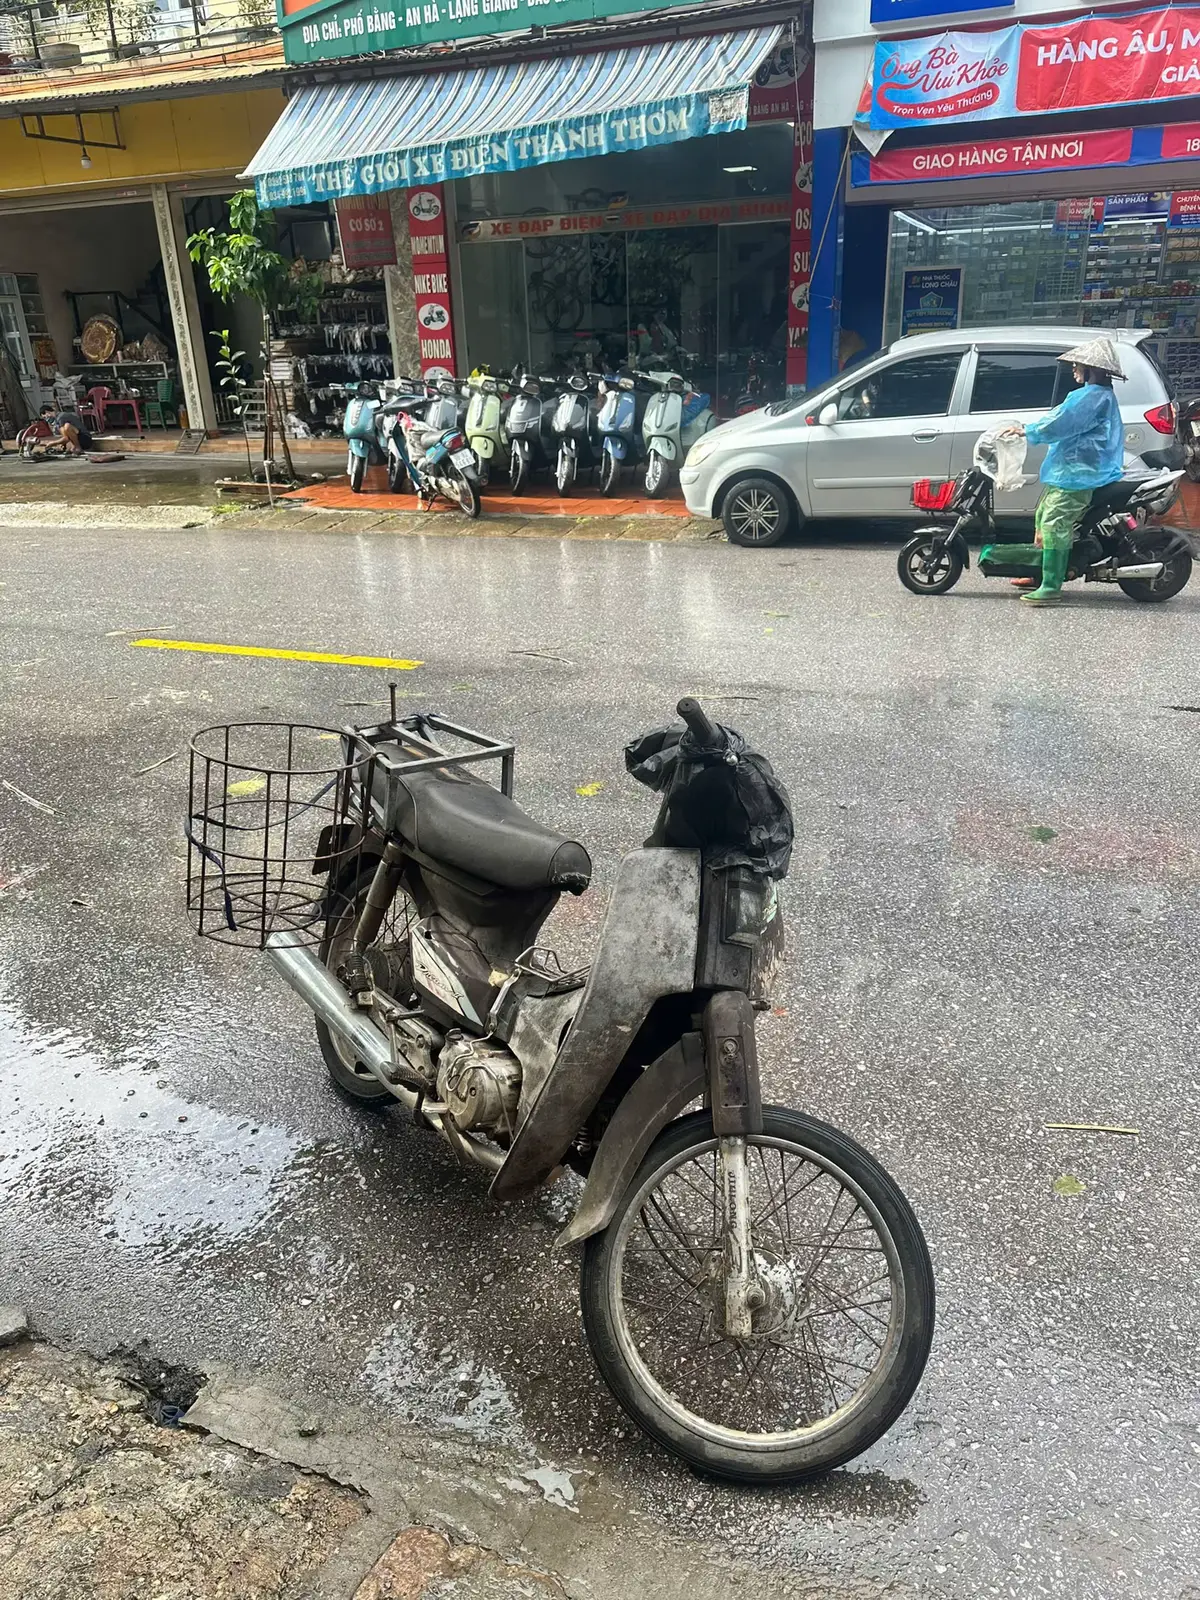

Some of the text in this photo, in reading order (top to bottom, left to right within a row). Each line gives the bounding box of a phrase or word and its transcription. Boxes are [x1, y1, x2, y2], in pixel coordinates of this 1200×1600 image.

[303, 24, 320, 48] ĐỊA
[321, 14, 343, 41] CHỈ:
[343, 8, 365, 37] PHỐ
[366, 7, 396, 34] BẰNG
[405, 6, 421, 27] AN
[423, 0, 440, 24] HÀ
[449, 0, 479, 24] LẠNG
[881, 44, 960, 79] Ông Bà
[1037, 37, 1119, 66] HÀNG
[1124, 29, 1174, 55] ÂU,
[921, 58, 1010, 93] Vui Khỏe
[892, 105, 914, 116] Trọn
[916, 106, 935, 116] Vẹn
[957, 88, 993, 106] Thương
[314, 159, 355, 192] THẾ
[412, 153, 444, 177] XE
[451, 140, 509, 174] ĐIỆN
[912, 140, 1083, 171] GIAO HÀNG TẬN NƠI
[378, 220, 384, 232] 2
[490, 222, 512, 236] XE
[518, 219, 554, 236] ĐẠP
[413, 273, 448, 294] NIKE BIKE
[421, 339, 452, 359] HONDA
